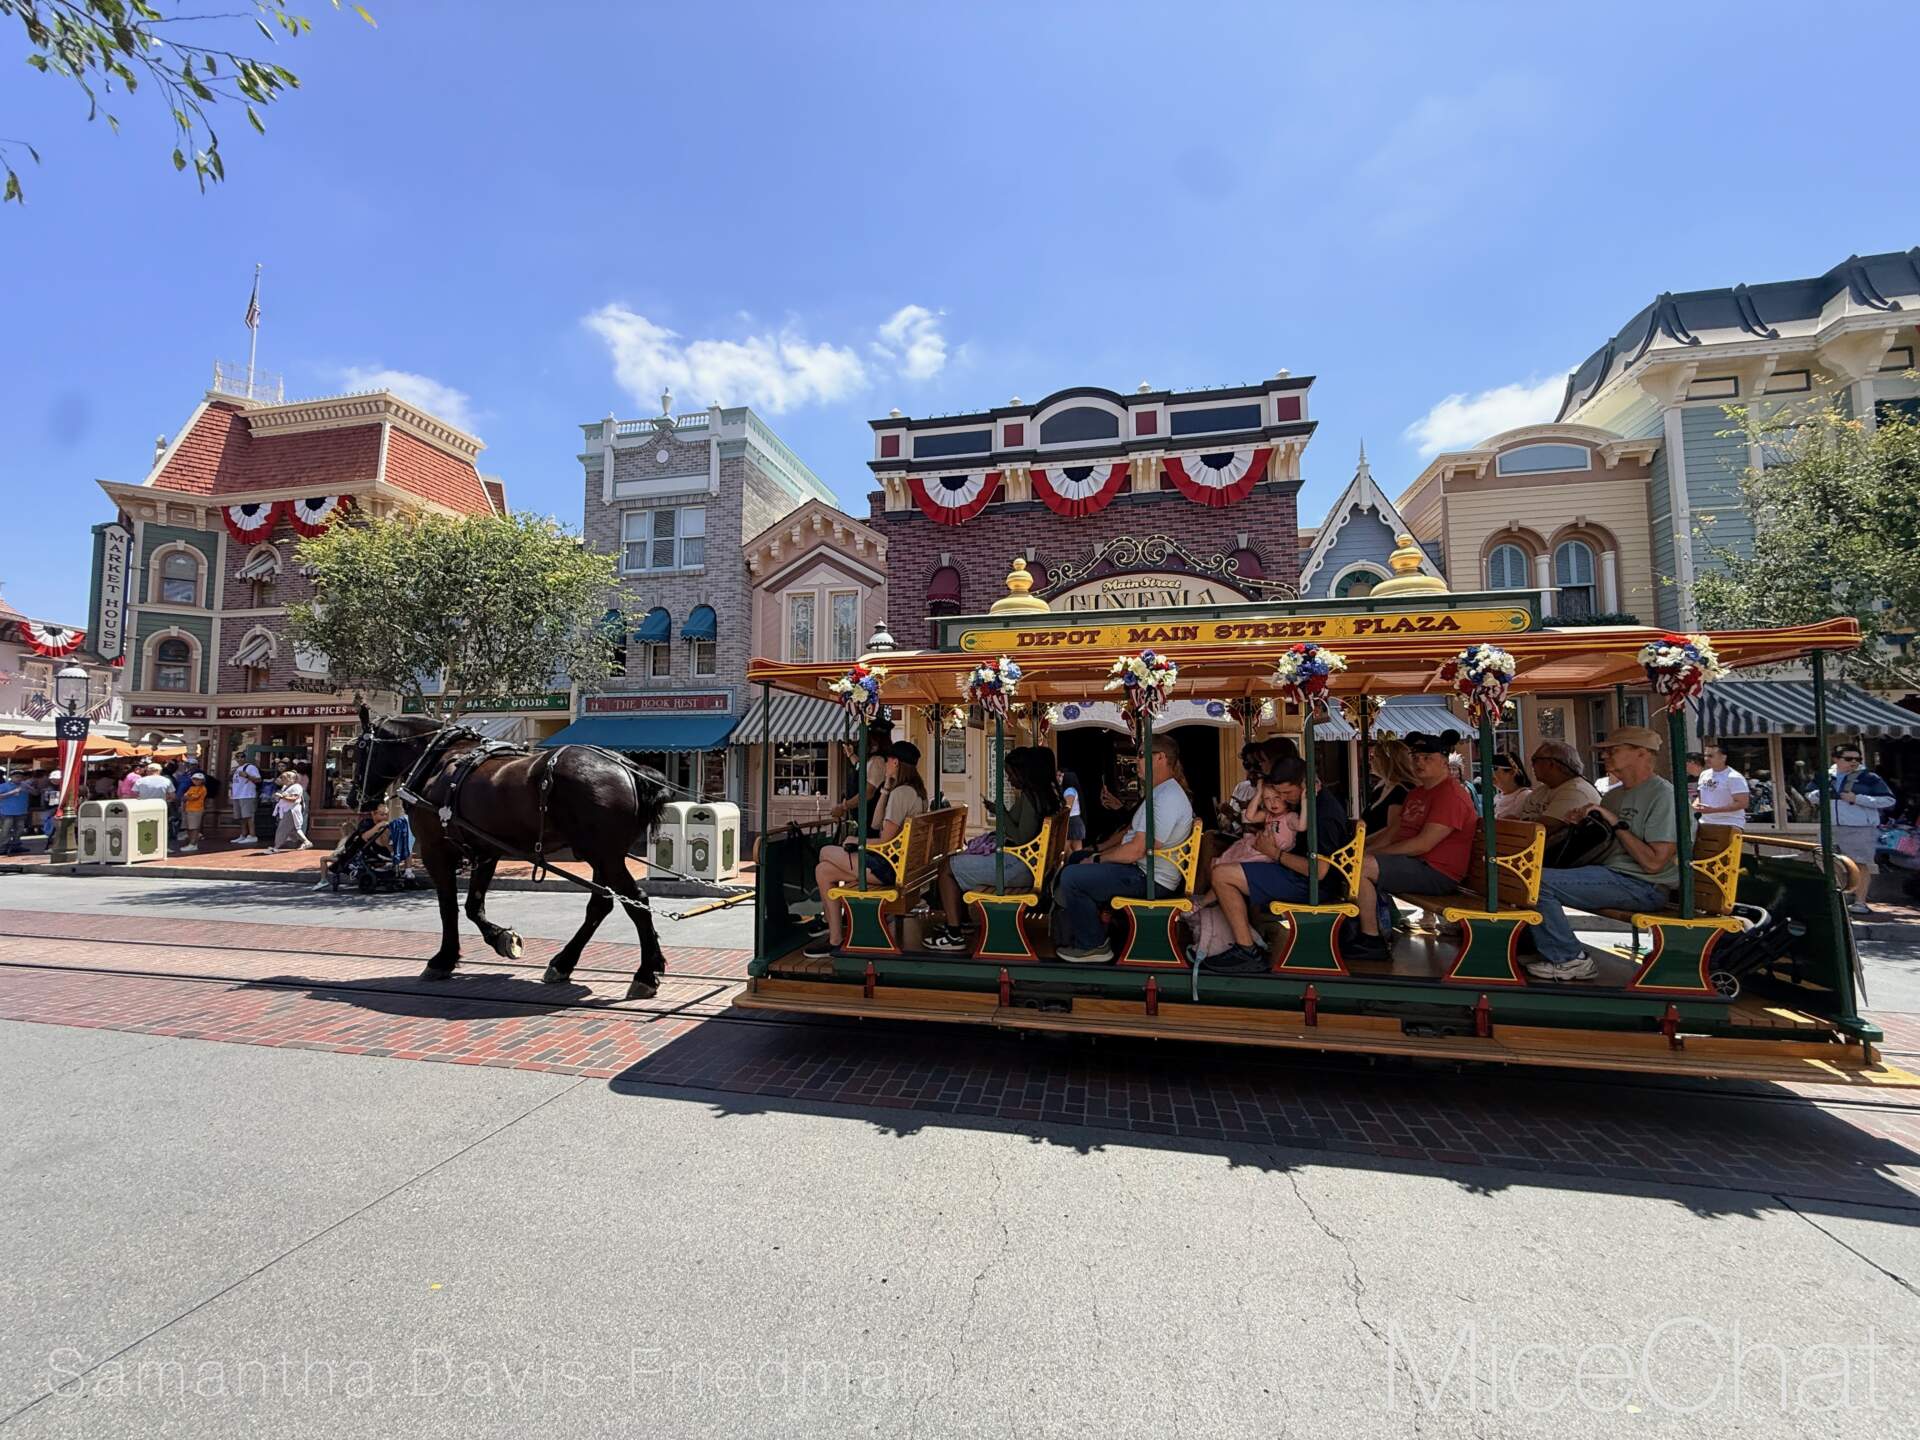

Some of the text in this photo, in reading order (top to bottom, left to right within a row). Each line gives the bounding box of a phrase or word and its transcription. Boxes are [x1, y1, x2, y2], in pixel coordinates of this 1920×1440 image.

[1102, 576, 1181, 592] Main Street
[103, 532, 124, 650] MARKET HOUSE
[1016, 615, 1461, 647] DEPOT MAIN STREET PLAZA
[511, 697, 549, 707] GOODS
[615, 698, 698, 710] THE BOOK REST
[153, 707, 186, 717] TEA
[229, 705, 347, 717] COFFEE RARE SPICES
